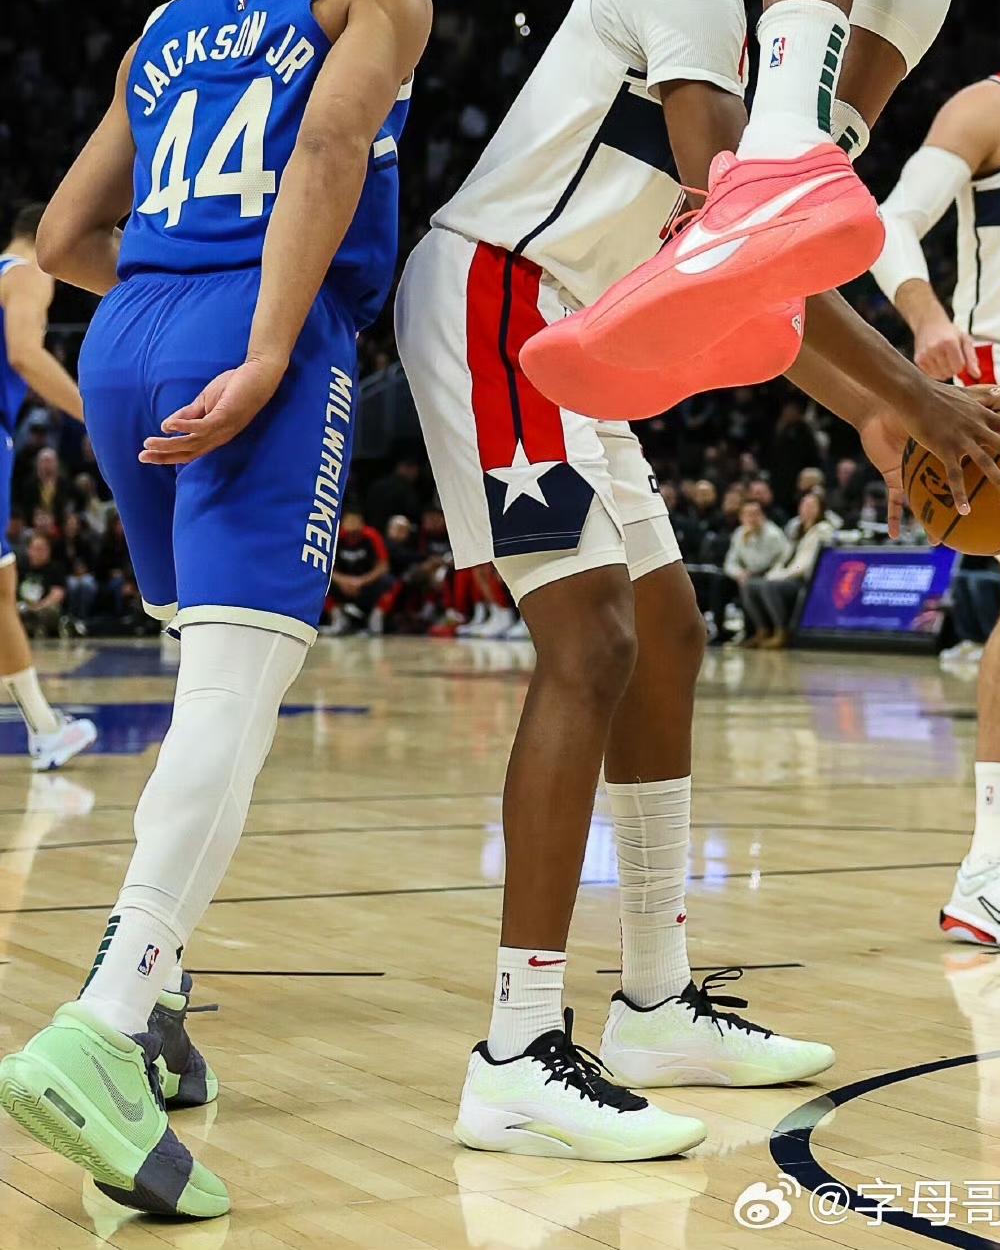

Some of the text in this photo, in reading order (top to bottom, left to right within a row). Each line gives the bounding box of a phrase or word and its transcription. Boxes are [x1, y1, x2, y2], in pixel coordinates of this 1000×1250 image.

[133, 10, 315, 117] JACKSON JR
[136, 76, 276, 229] 44
[301, 365, 353, 574] MILWAUKEE
